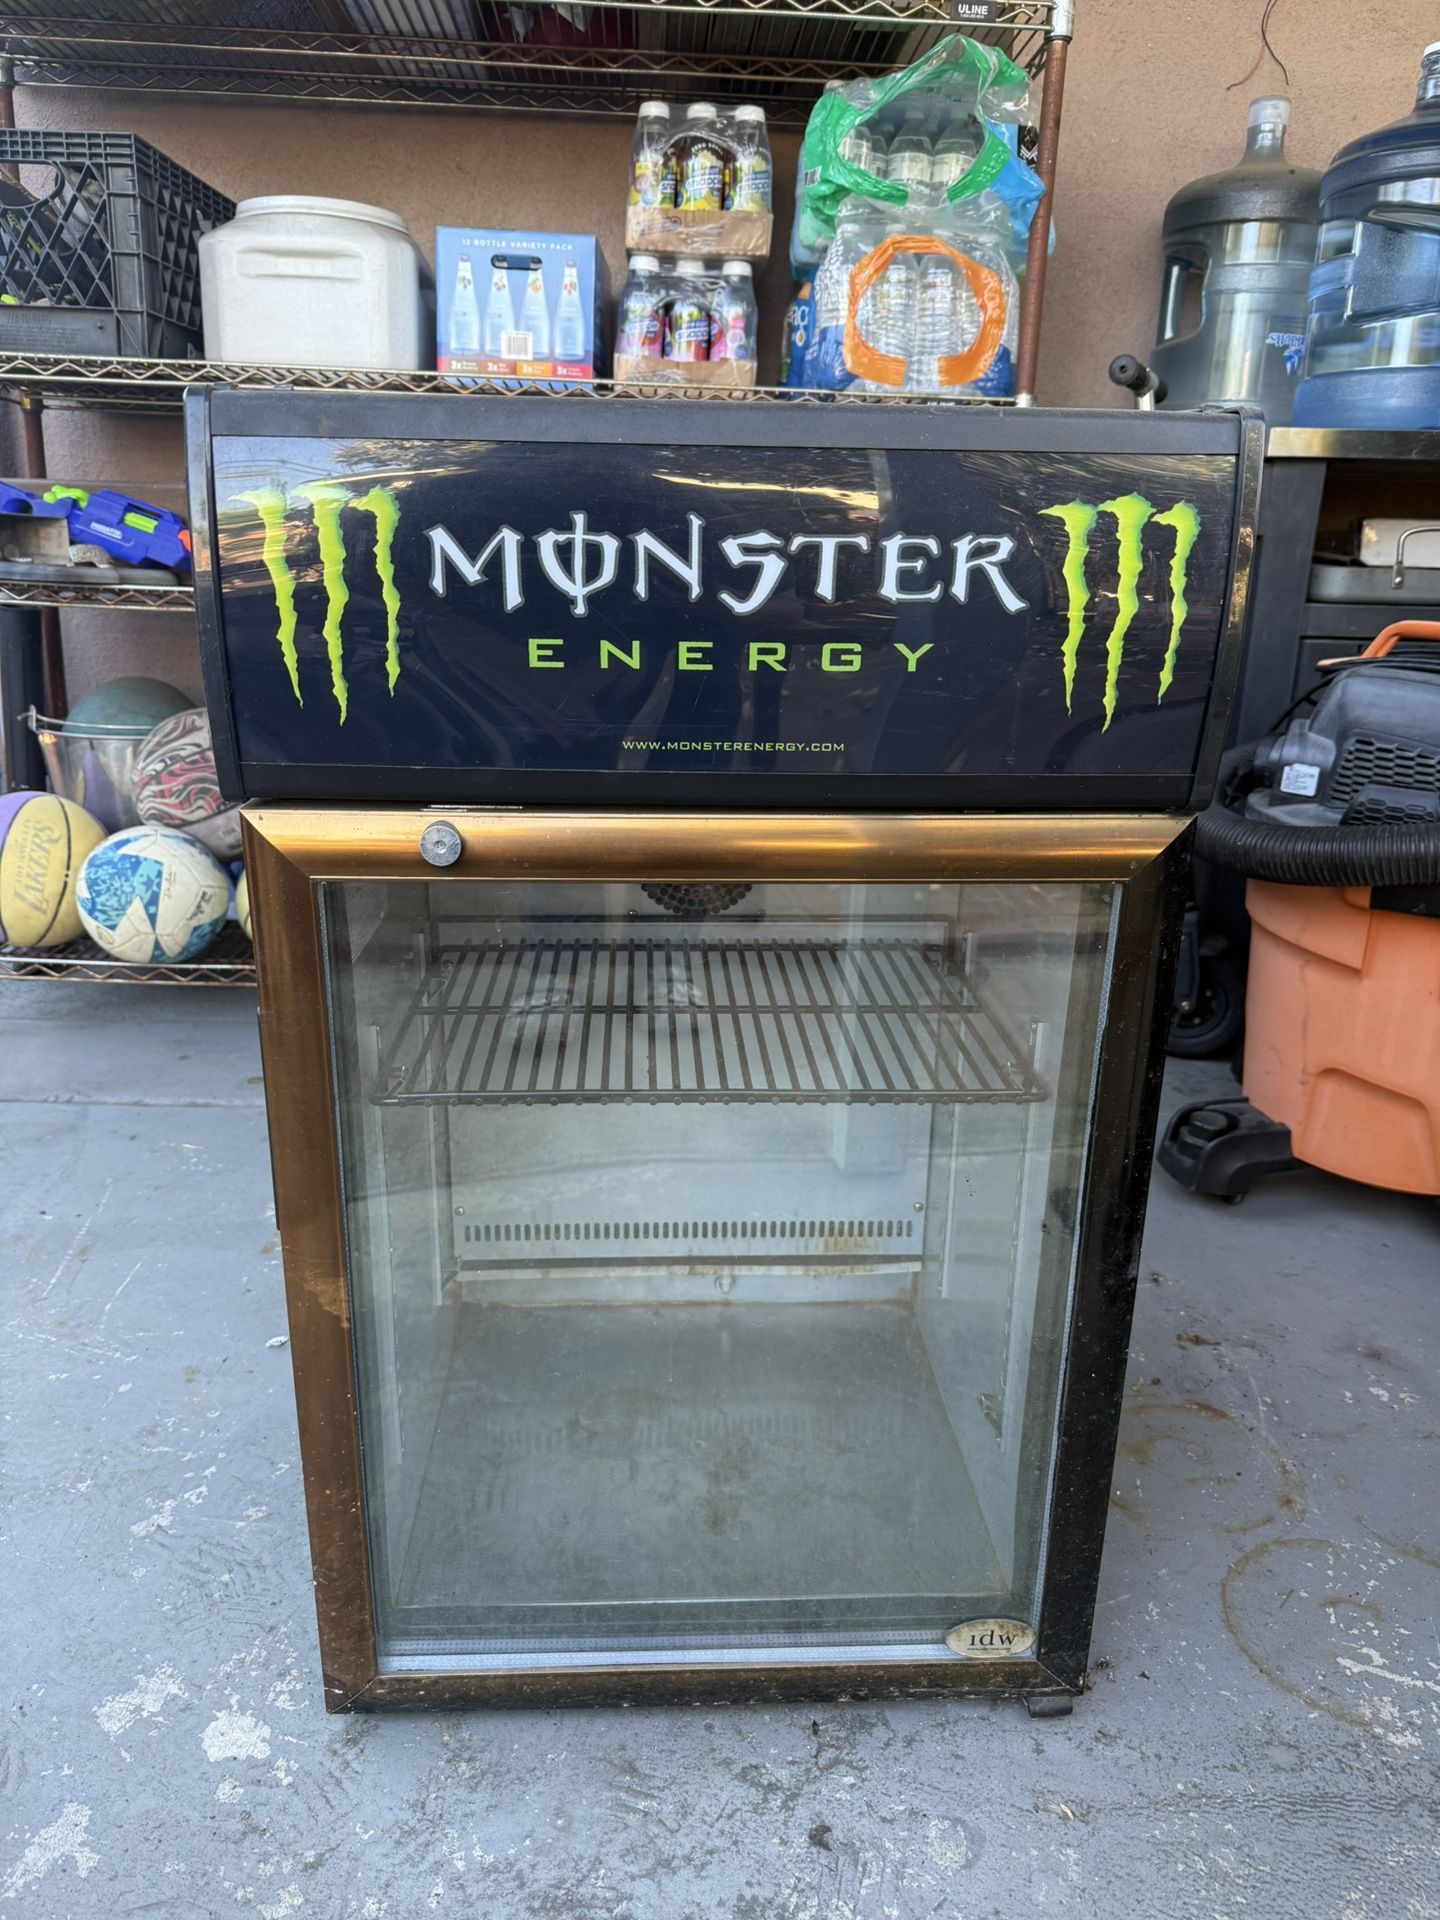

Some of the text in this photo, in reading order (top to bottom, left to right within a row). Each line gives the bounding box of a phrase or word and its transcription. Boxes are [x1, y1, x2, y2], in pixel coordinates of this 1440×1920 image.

[958, 4, 989, 15] ULINE
[462, 238, 573, 251] 12 BOTTLE VARIETY PACK
[423, 511, 1030, 618] MONSTER
[528, 638, 935, 673] ENERGY
[622, 740, 845, 752] WWW.MONSTERENERGY.COM
[14, 820, 62, 916] LAKERS
